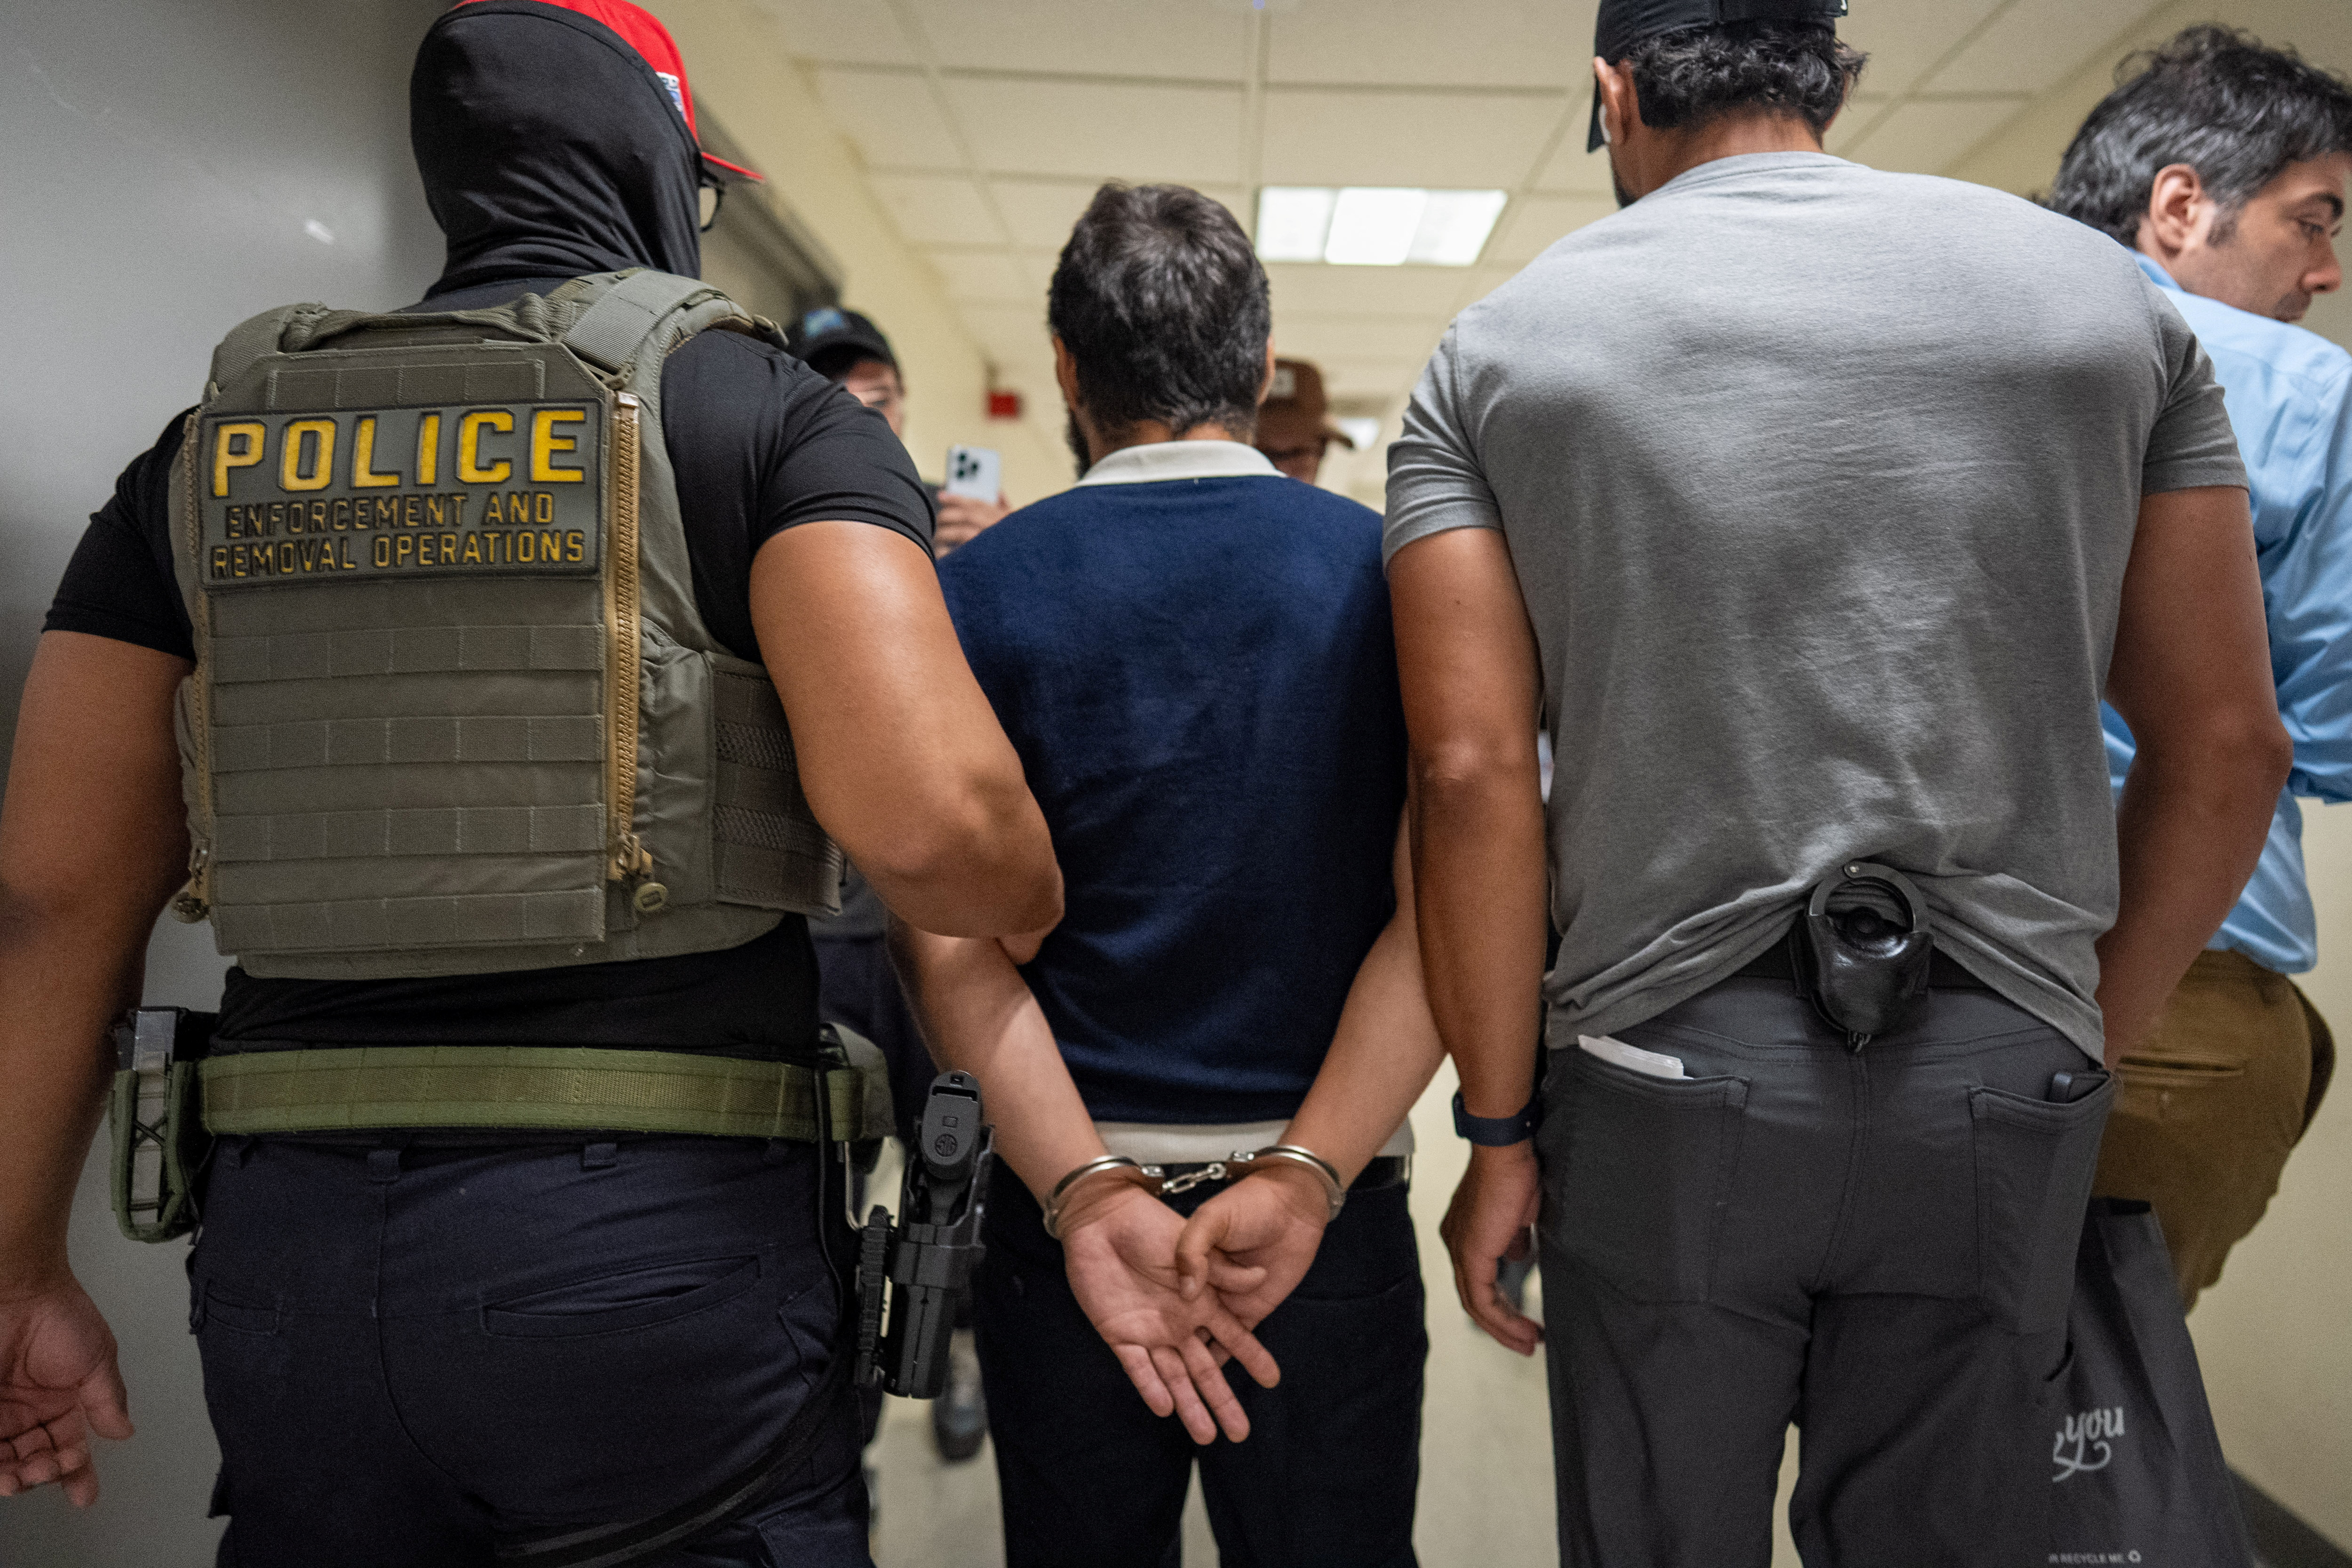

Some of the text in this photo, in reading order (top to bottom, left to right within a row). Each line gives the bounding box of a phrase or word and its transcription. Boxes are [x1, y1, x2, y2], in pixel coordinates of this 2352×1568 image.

[213, 408, 585, 497] POLICE
[227, 492, 554, 539] ENFORCEMENT AND
[212, 531, 584, 578] REMOVAL OPERATIONS
